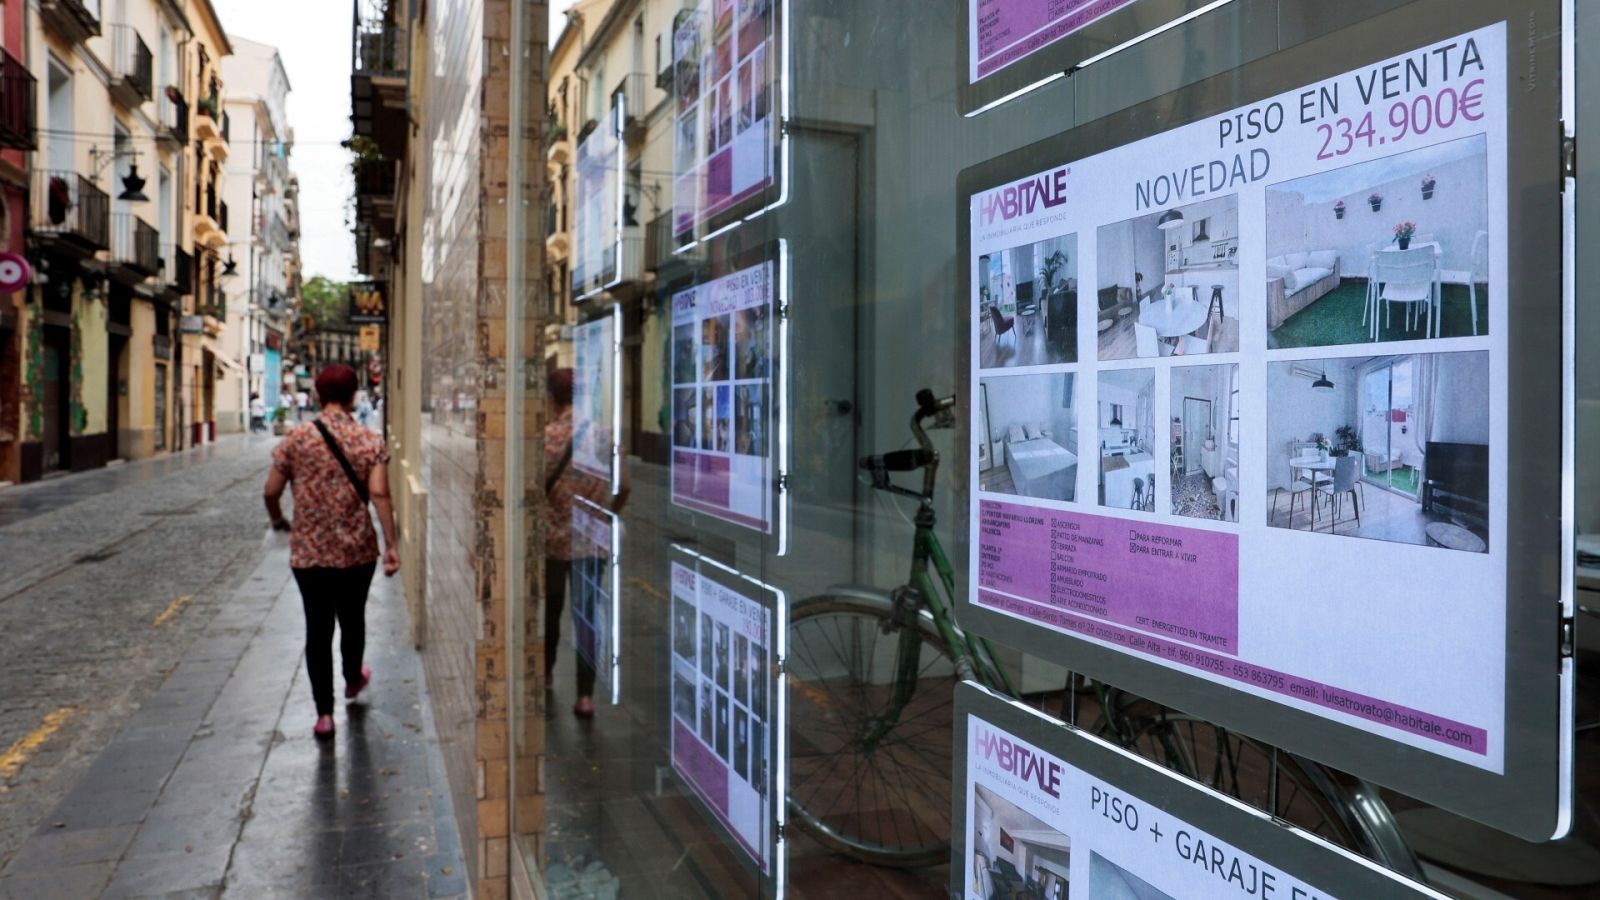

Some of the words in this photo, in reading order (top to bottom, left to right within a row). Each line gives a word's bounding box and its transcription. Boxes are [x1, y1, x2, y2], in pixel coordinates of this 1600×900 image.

[1220, 102, 1284, 148] PISO
[1300, 82, 1338, 124] EN
[1356, 37, 1484, 106] VENTA
[1316, 79, 1484, 160] 234.900€
[1135, 148, 1270, 211] NOVEDAD
[1023, 221, 1034, 230] QUE
[1036, 212, 1066, 226] RESPONDE
[1057, 521, 1080, 530] ASCENSOR
[1056, 542, 1076, 552] TERRAZA
[1057, 532, 1070, 540] PATIO
[1078, 536, 1104, 546] MANZANAS
[1136, 532, 1150, 542] PARA
[1151, 536, 1182, 548] REFORMAR
[1136, 544, 1150, 554] PARA
[1152, 548, 1173, 558] ENTRAR
[1181, 553, 1197, 563] VIVIR
[1057, 564, 1078, 575] ARMARIO
[1078, 569, 1108, 582] EMPOTRADO
[1057, 575, 1084, 588] AMUEBLADO
[1068, 600, 1108, 616] ACONDICIONADO
[1152, 620, 1188, 636] ENERGETICO
[1189, 630, 1198, 639] EN
[1199, 632, 1228, 646] TRAMITE
[1086, 622, 1094, 633] 29
[1096, 628, 1112, 640] cruce
[1114, 632, 1126, 642] con
[1130, 635, 1146, 646] Calle
[1148, 641, 1160, 652] Alta
[1180, 650, 1194, 662] 960
[1196, 654, 1224, 672] 910755
[1232, 664, 1248, 678] 653
[1252, 670, 1284, 689] 863795
[1290, 682, 1318, 700] email:
[1322, 689, 1472, 745] luisatrovato@habitale.com
[1092, 786, 1138, 831] PISO
[1150, 822, 1163, 843] +
[1176, 830, 1276, 900] GARAJE
